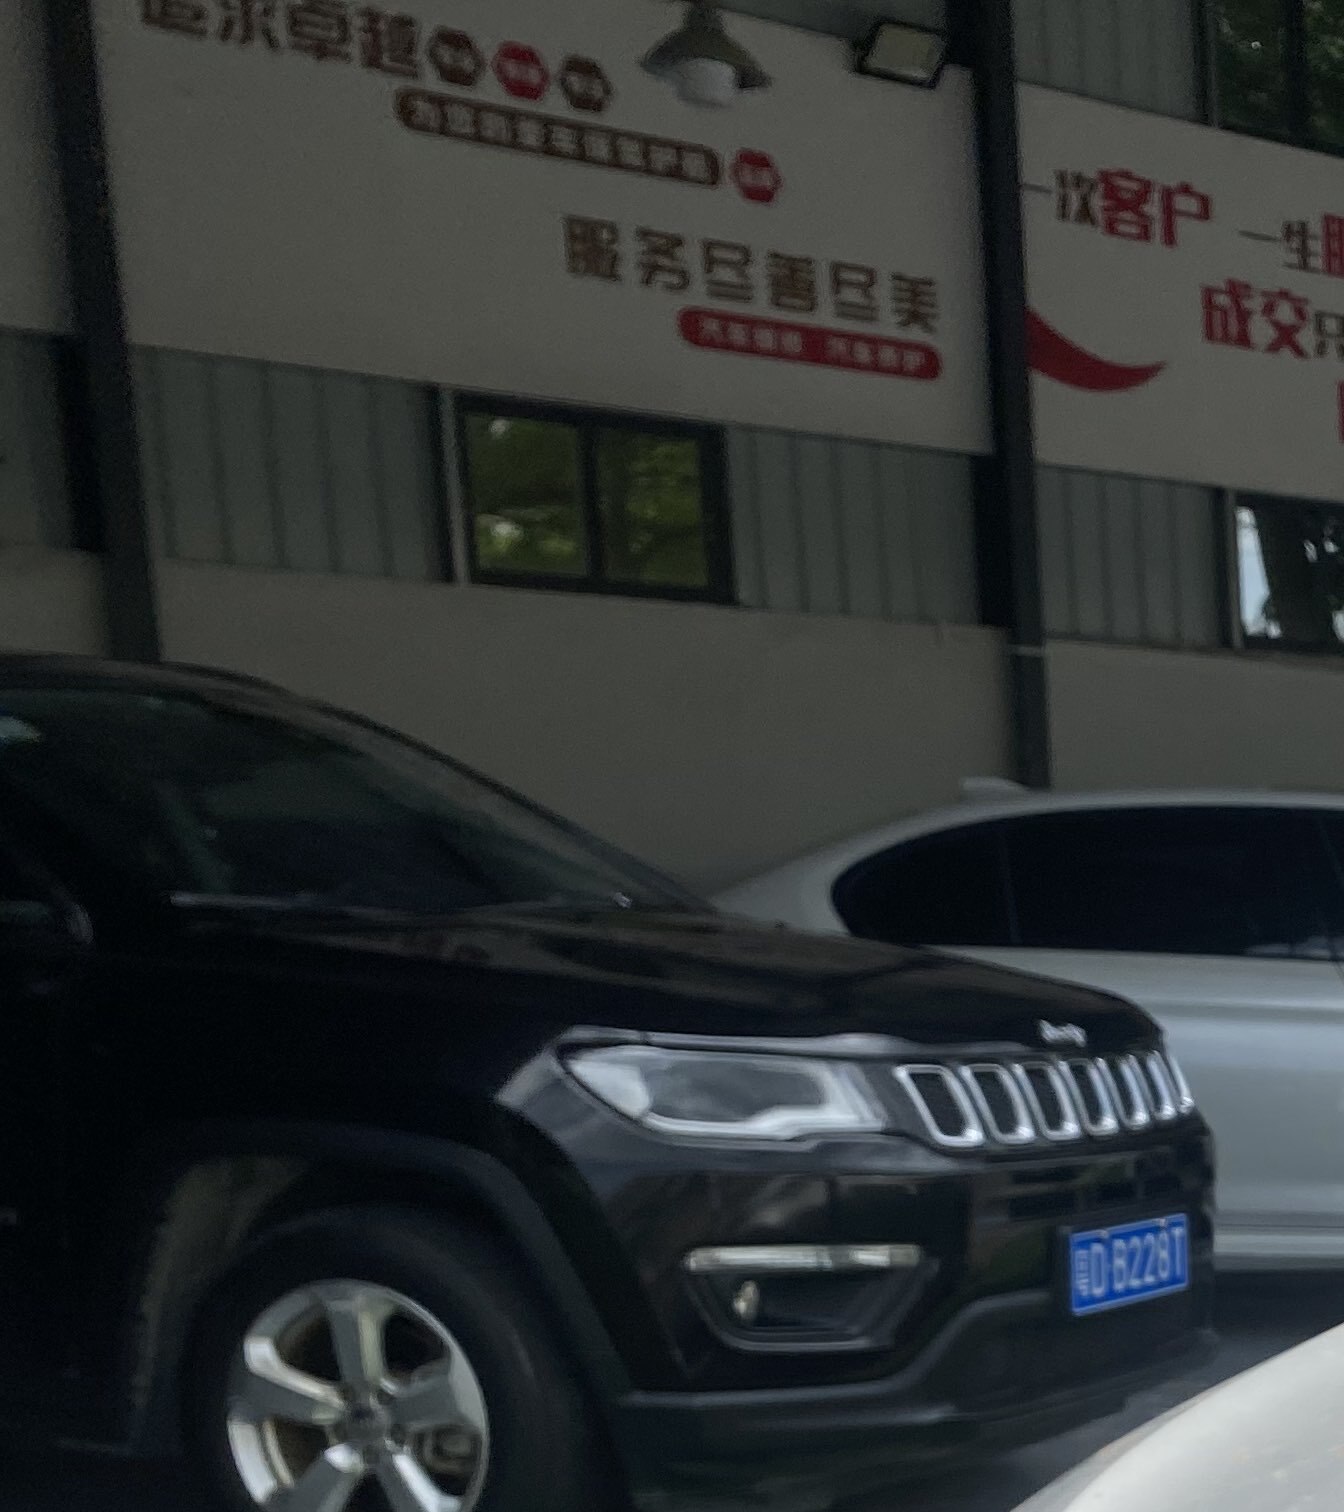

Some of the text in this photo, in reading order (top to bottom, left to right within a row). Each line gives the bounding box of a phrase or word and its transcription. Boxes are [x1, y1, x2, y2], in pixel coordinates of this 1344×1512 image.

[565, 215, 940, 334] 服务尽善尽美
